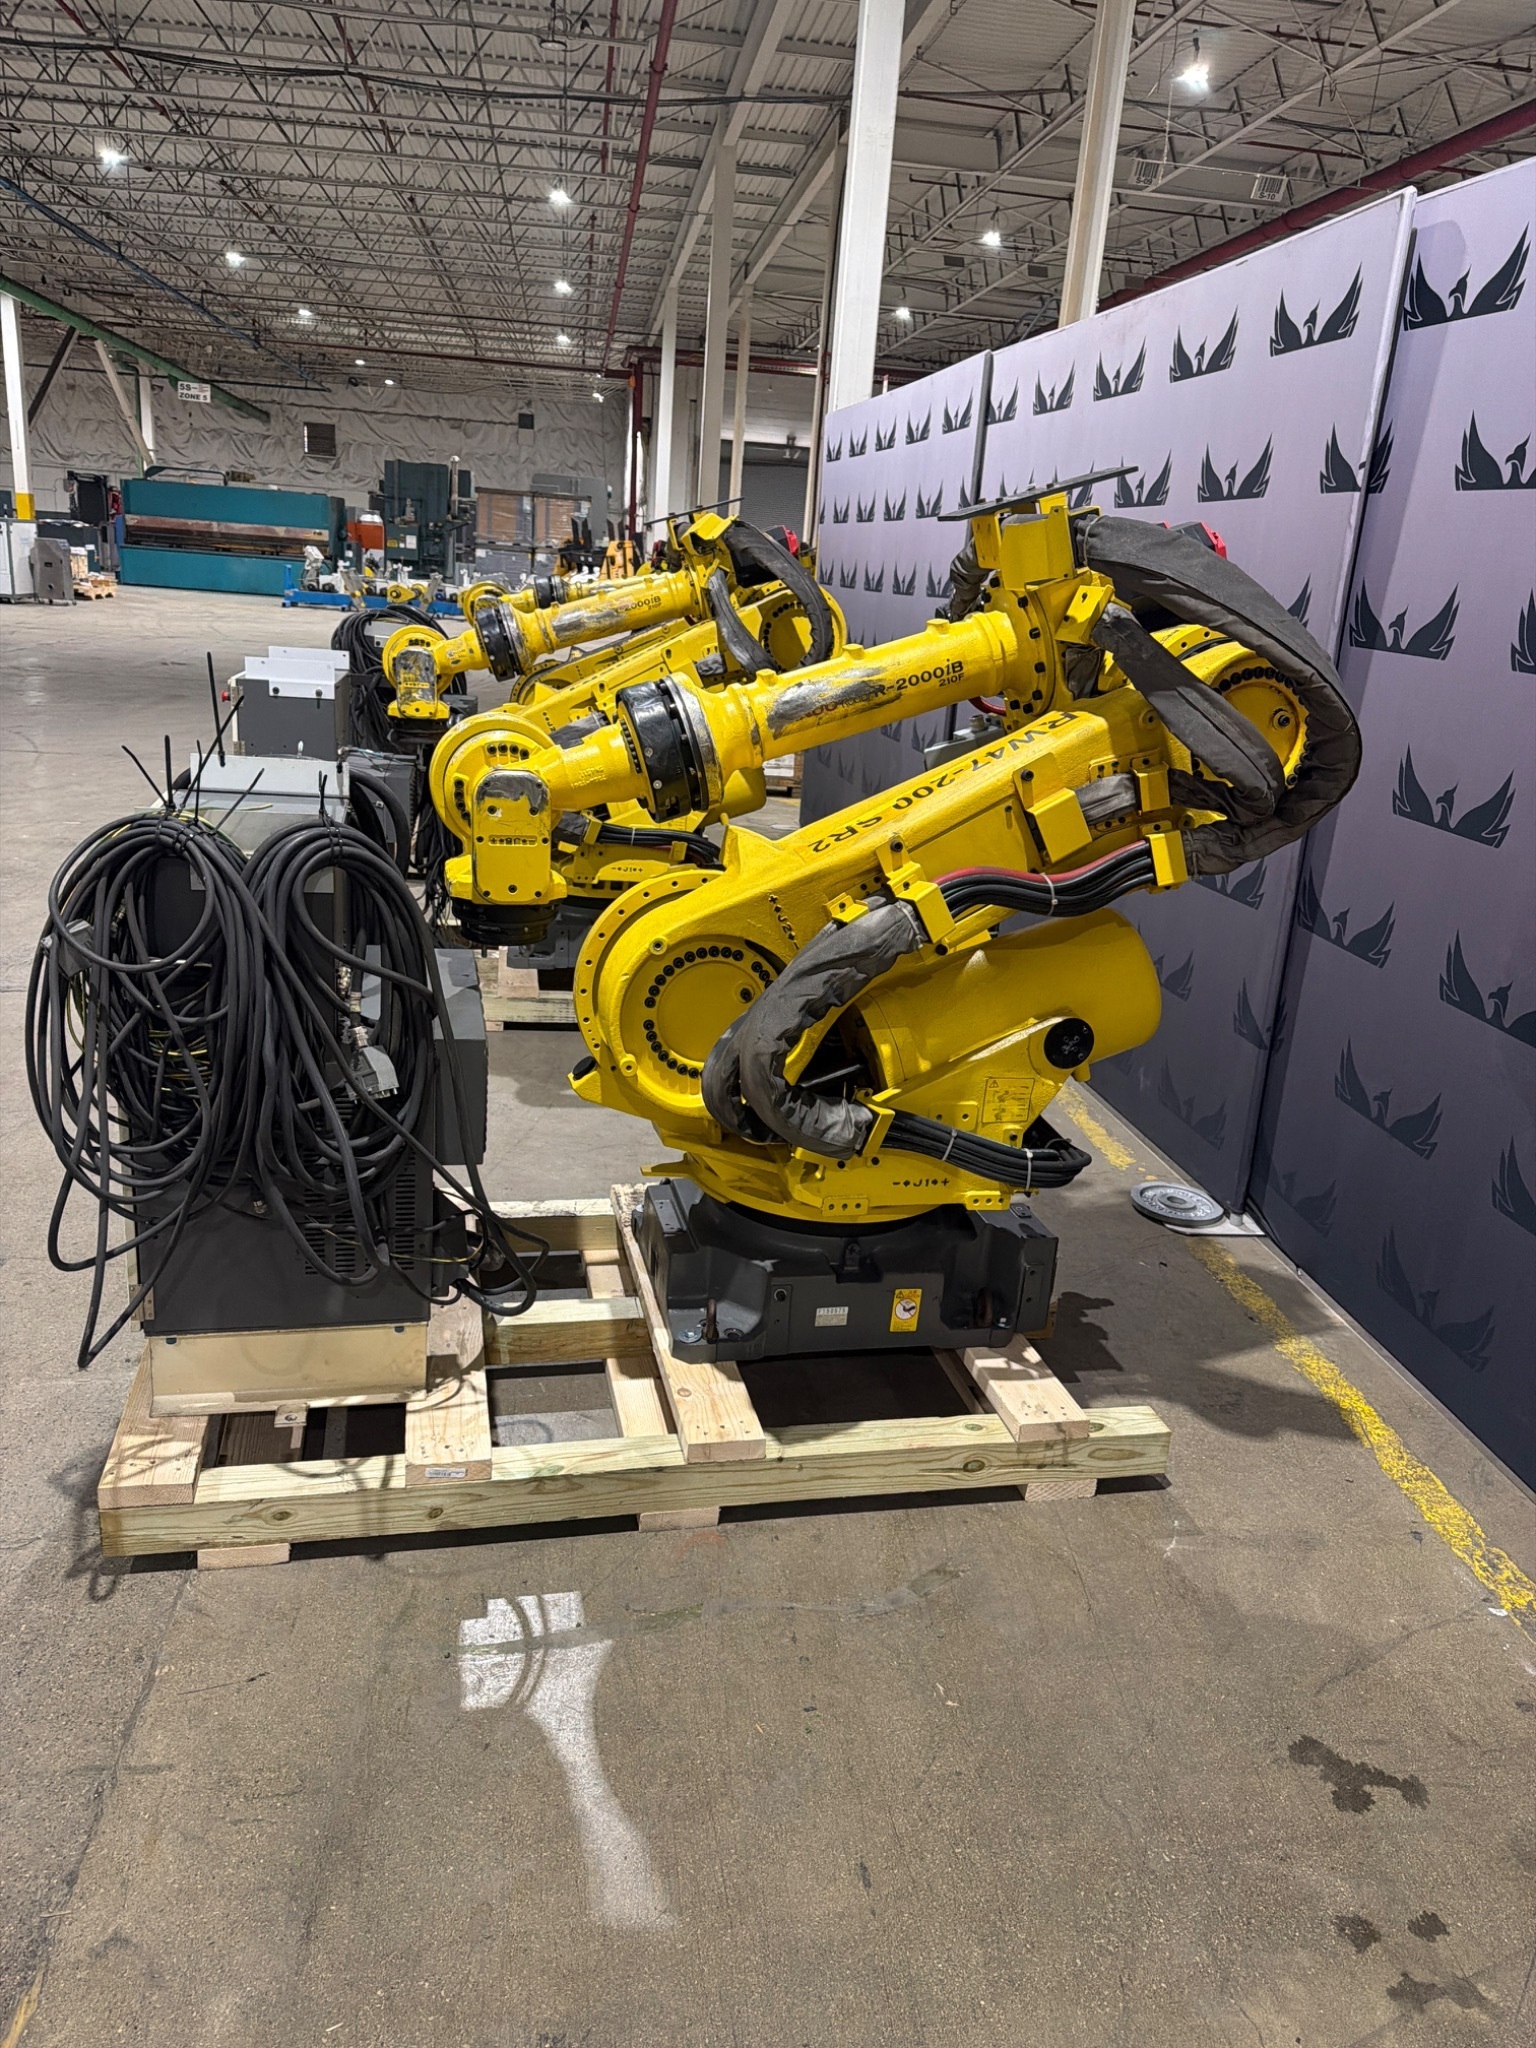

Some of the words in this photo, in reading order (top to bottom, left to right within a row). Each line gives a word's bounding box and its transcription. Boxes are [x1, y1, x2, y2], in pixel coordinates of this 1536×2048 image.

[1259, 192, 1275, 200] S-10
[180, 392, 200, 400] ZONE
[938, 673, 965, 688] 210F
[891, 711, 1079, 811] RW47-200
[807, 816, 883, 853] SR2
